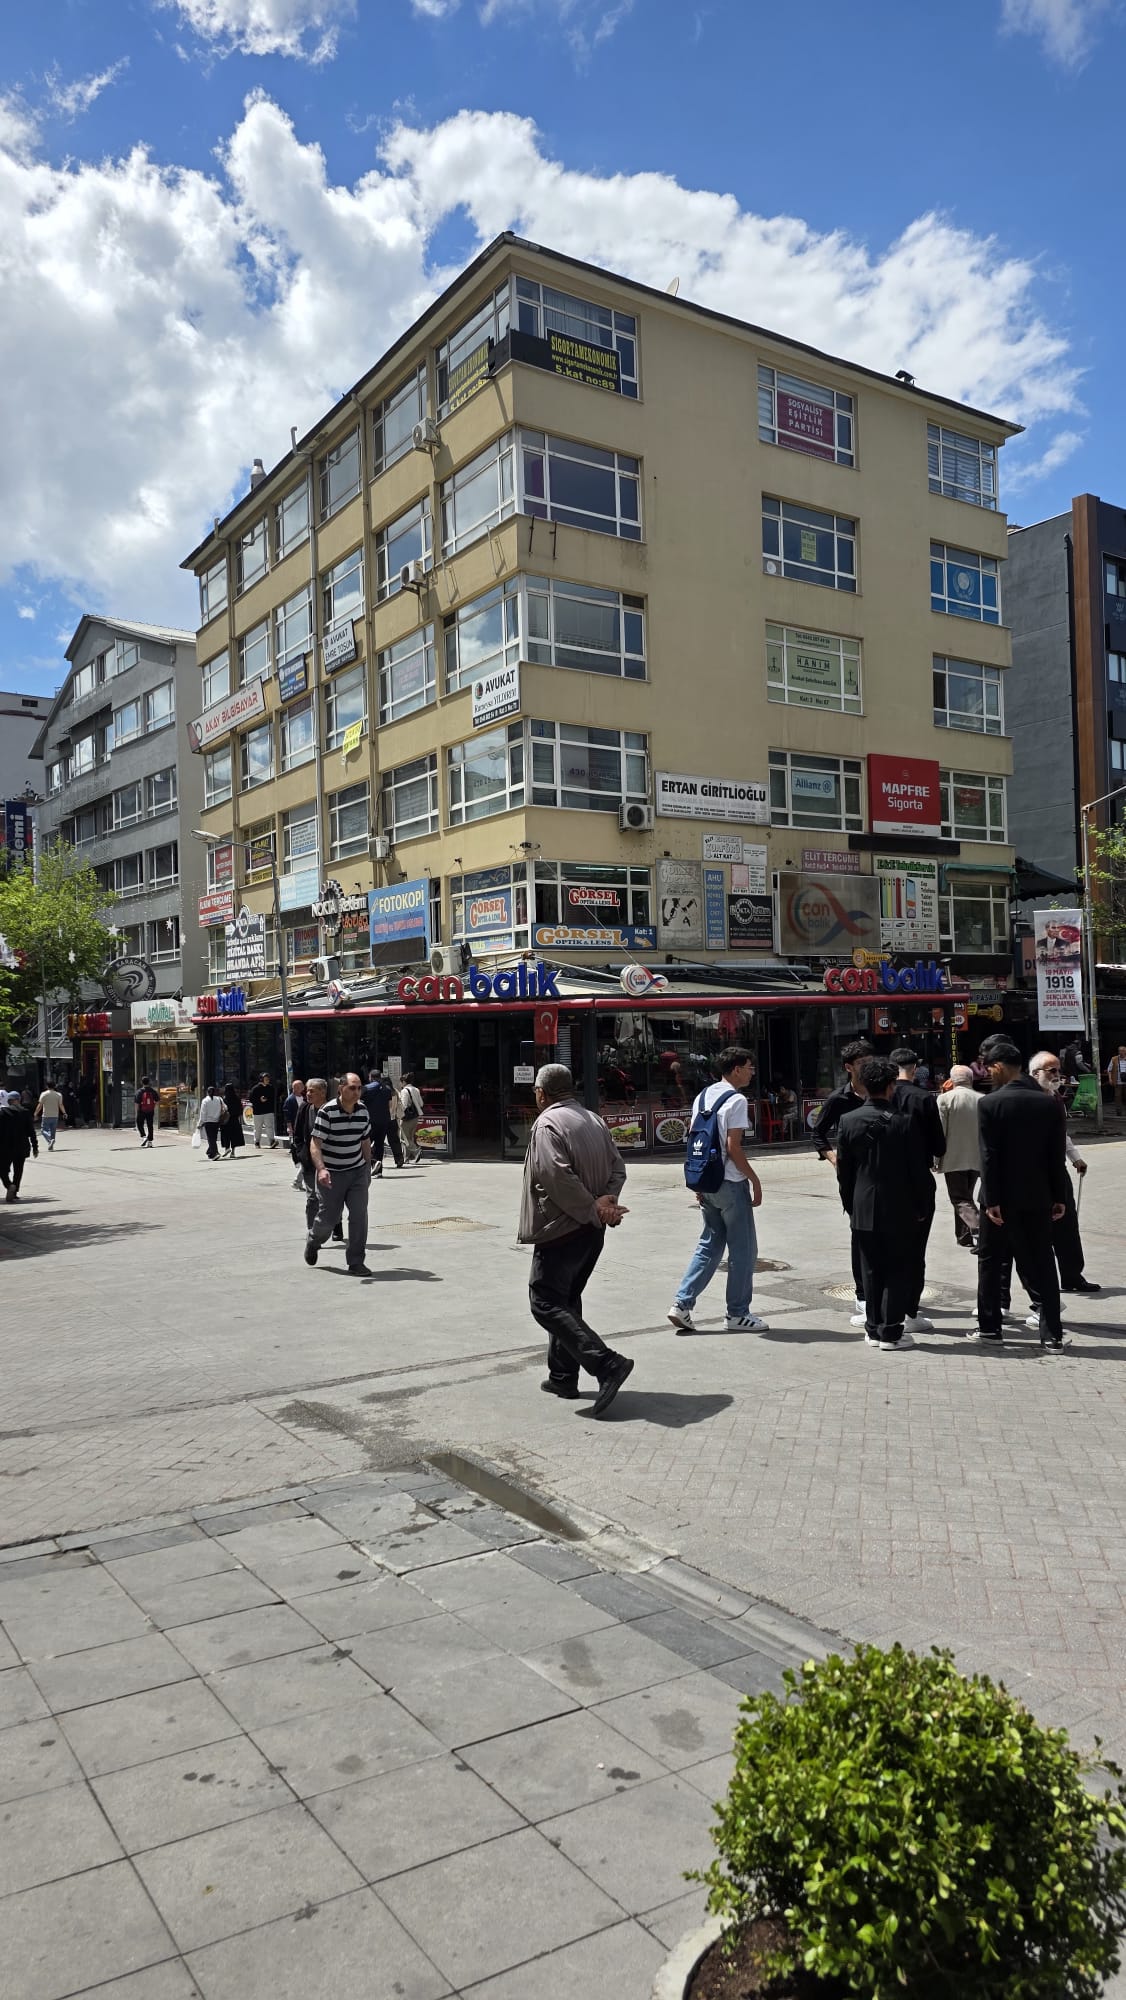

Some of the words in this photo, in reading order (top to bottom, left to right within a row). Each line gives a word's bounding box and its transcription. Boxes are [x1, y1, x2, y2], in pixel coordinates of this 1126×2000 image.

[788, 398, 823, 416] SOSYALİST
[788, 408, 823, 426] EŞİTLİK
[788, 419, 823, 437] PARTİSİ
[485, 669, 516, 694] AVUKAT
[661, 780, 698, 795] ERTAN
[700, 781, 766, 802] GİRİTLİOĞLU
[795, 777, 821, 791] Allianz
[882, 782, 930, 797] MAPFRE
[888, 796, 923, 812] Sigorta
[707, 874, 721, 882] AHU
[379, 884, 425, 914] FOTOKOPİ
[569, 888, 620, 906] GÖRSEL
[470, 897, 507, 928] GÖRSEL
[801, 903, 830, 917] can
[536, 926, 629, 947] GÖRSEL
[398, 974, 464, 1001] can
[824, 967, 878, 992] can
[1045, 975, 1075, 989] 1919
[196, 995, 217, 1014] can
